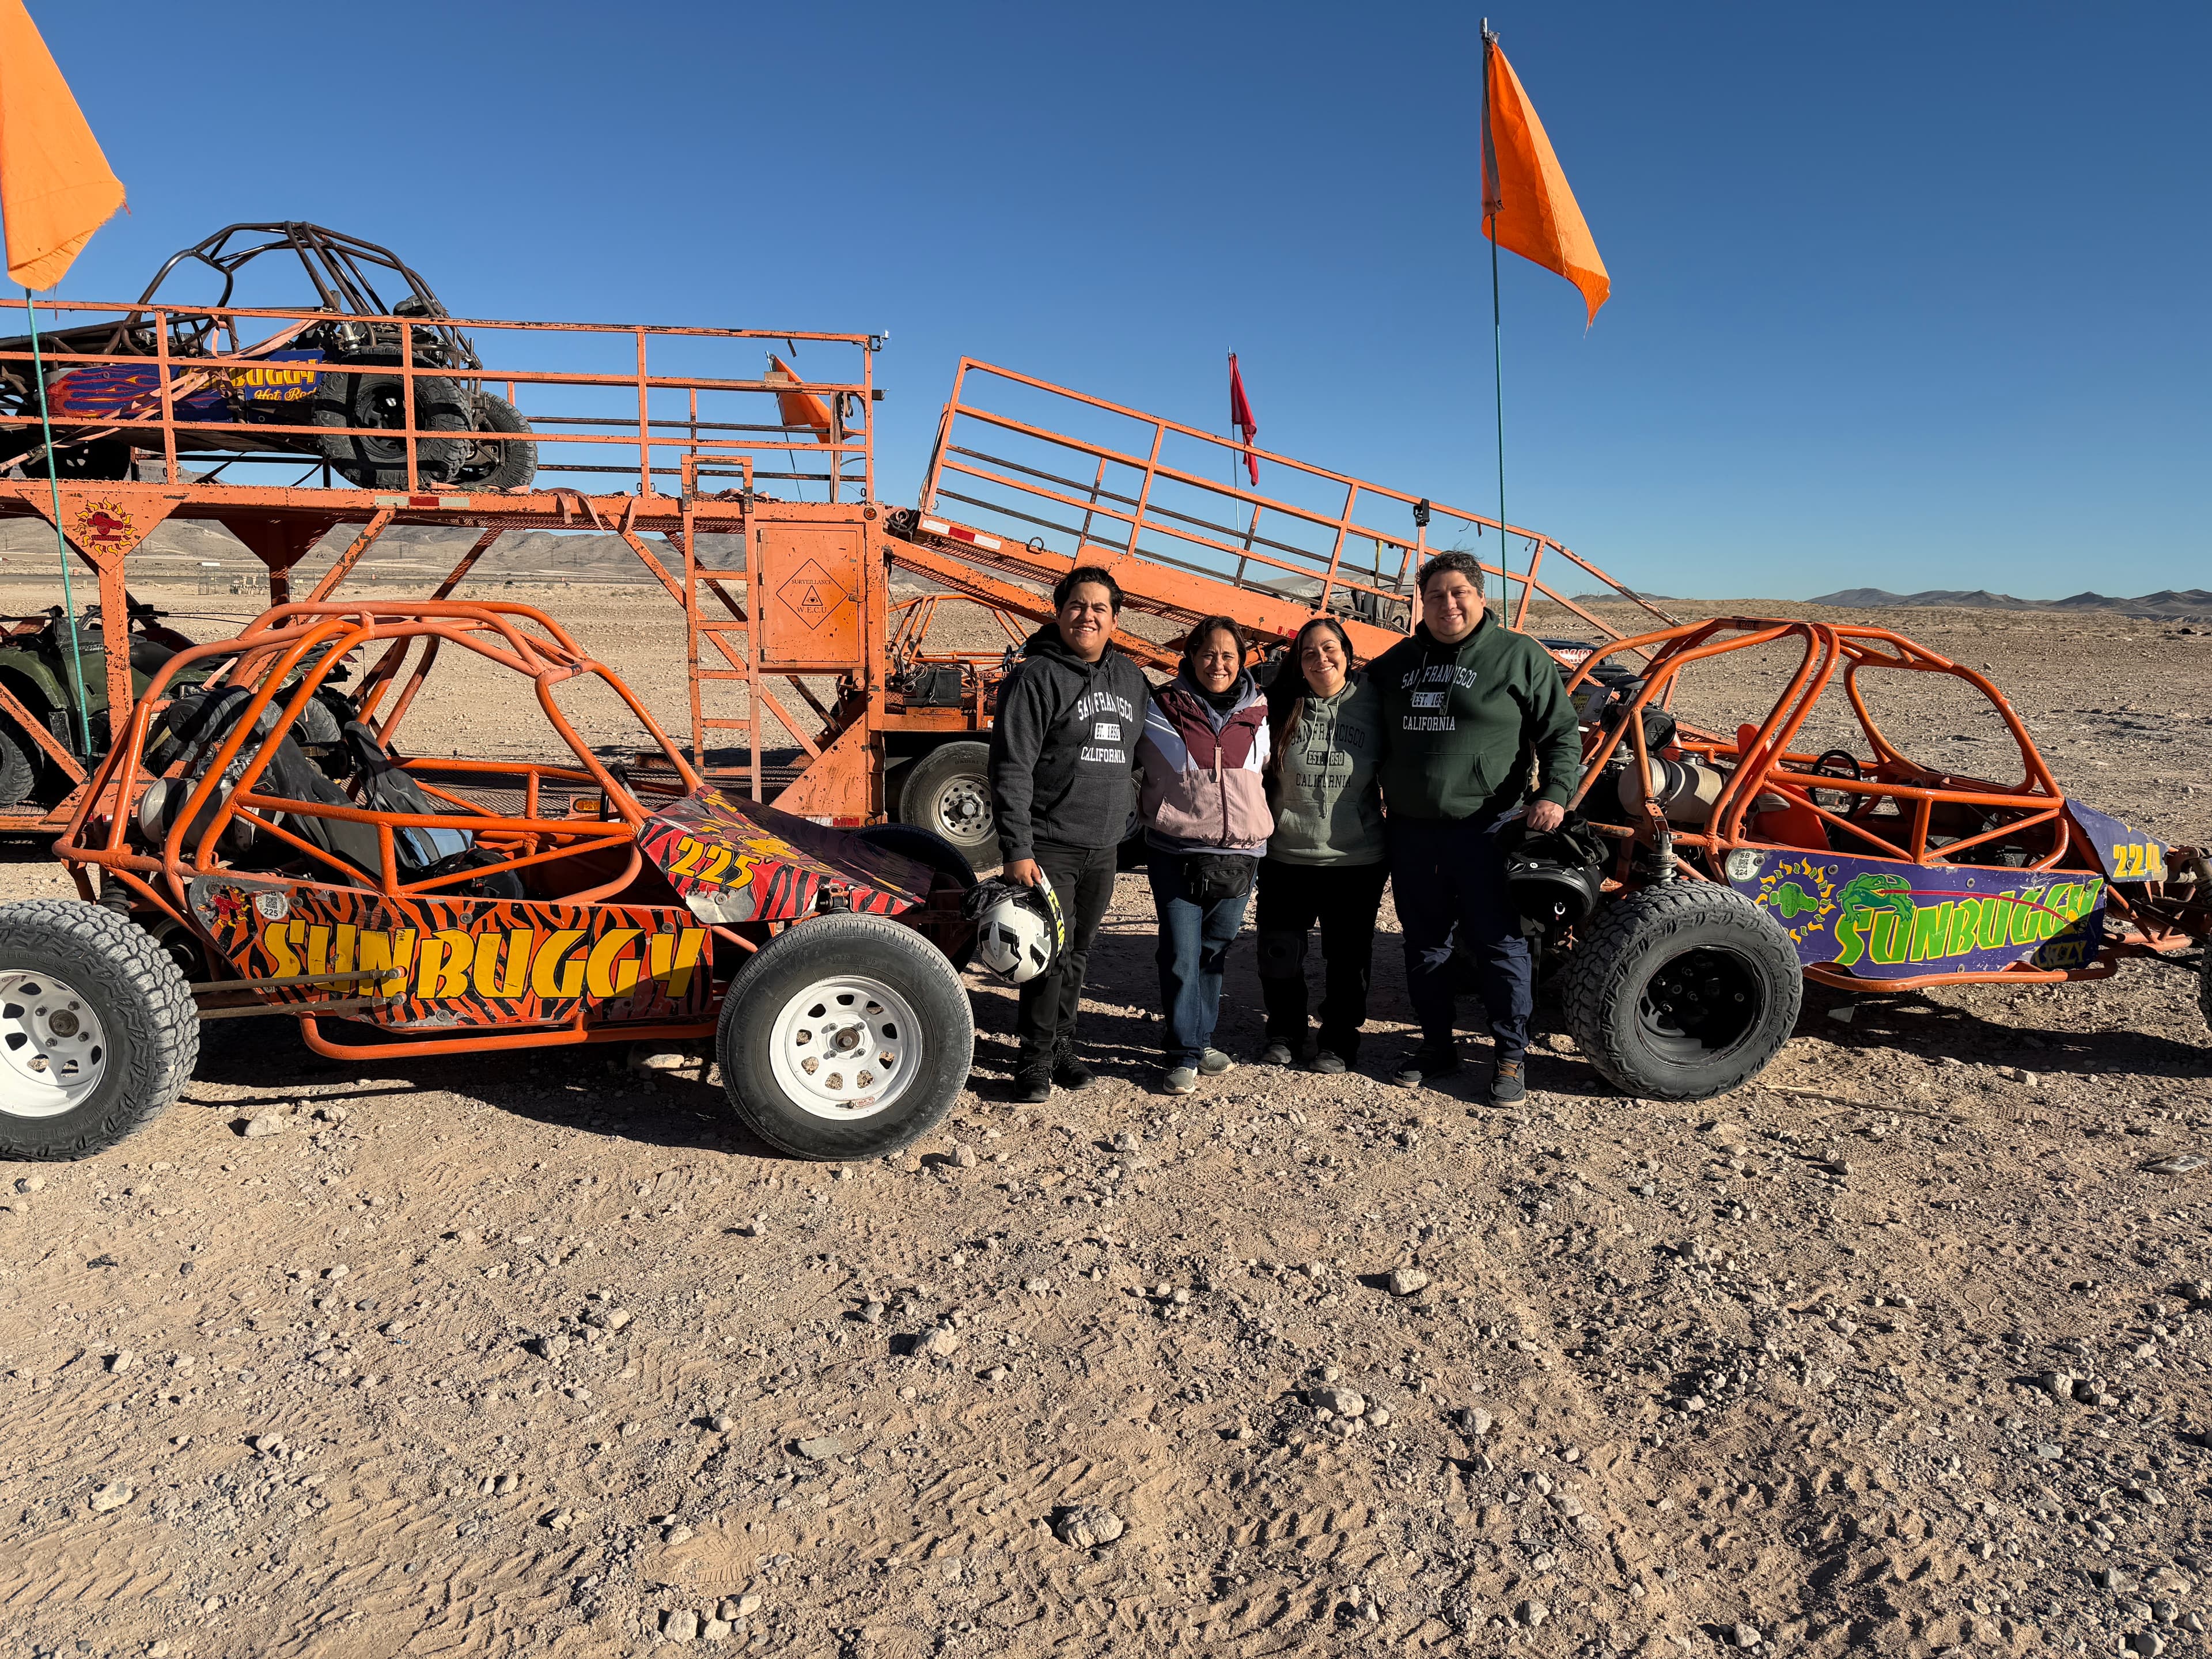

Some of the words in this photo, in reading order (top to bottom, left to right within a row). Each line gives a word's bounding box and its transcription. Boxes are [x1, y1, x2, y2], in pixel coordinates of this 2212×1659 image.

[1422, 664, 1478, 688] FRANISCO
[1094, 691, 1133, 723] FRANISCO
[1414, 694, 1428, 706] EST.
[1431, 694, 1445, 706] 185
[1107, 725, 1120, 739] 1850
[1403, 715, 1456, 731] CALIFORNIA
[1312, 723, 1365, 749] FRANCISCO
[1081, 747, 1126, 763] CALIFORNIA
[1308, 752, 1324, 765] EST.
[1327, 752, 1343, 765] 850
[1296, 774, 1351, 788] CALIFORNIA
[665, 835, 761, 889] 225
[2113, 842, 2162, 878] 224
[264, 907, 279, 917] 225
[1834, 878, 2103, 966] SUNBUGGY
[263, 919, 708, 999] SUNBUGGY
